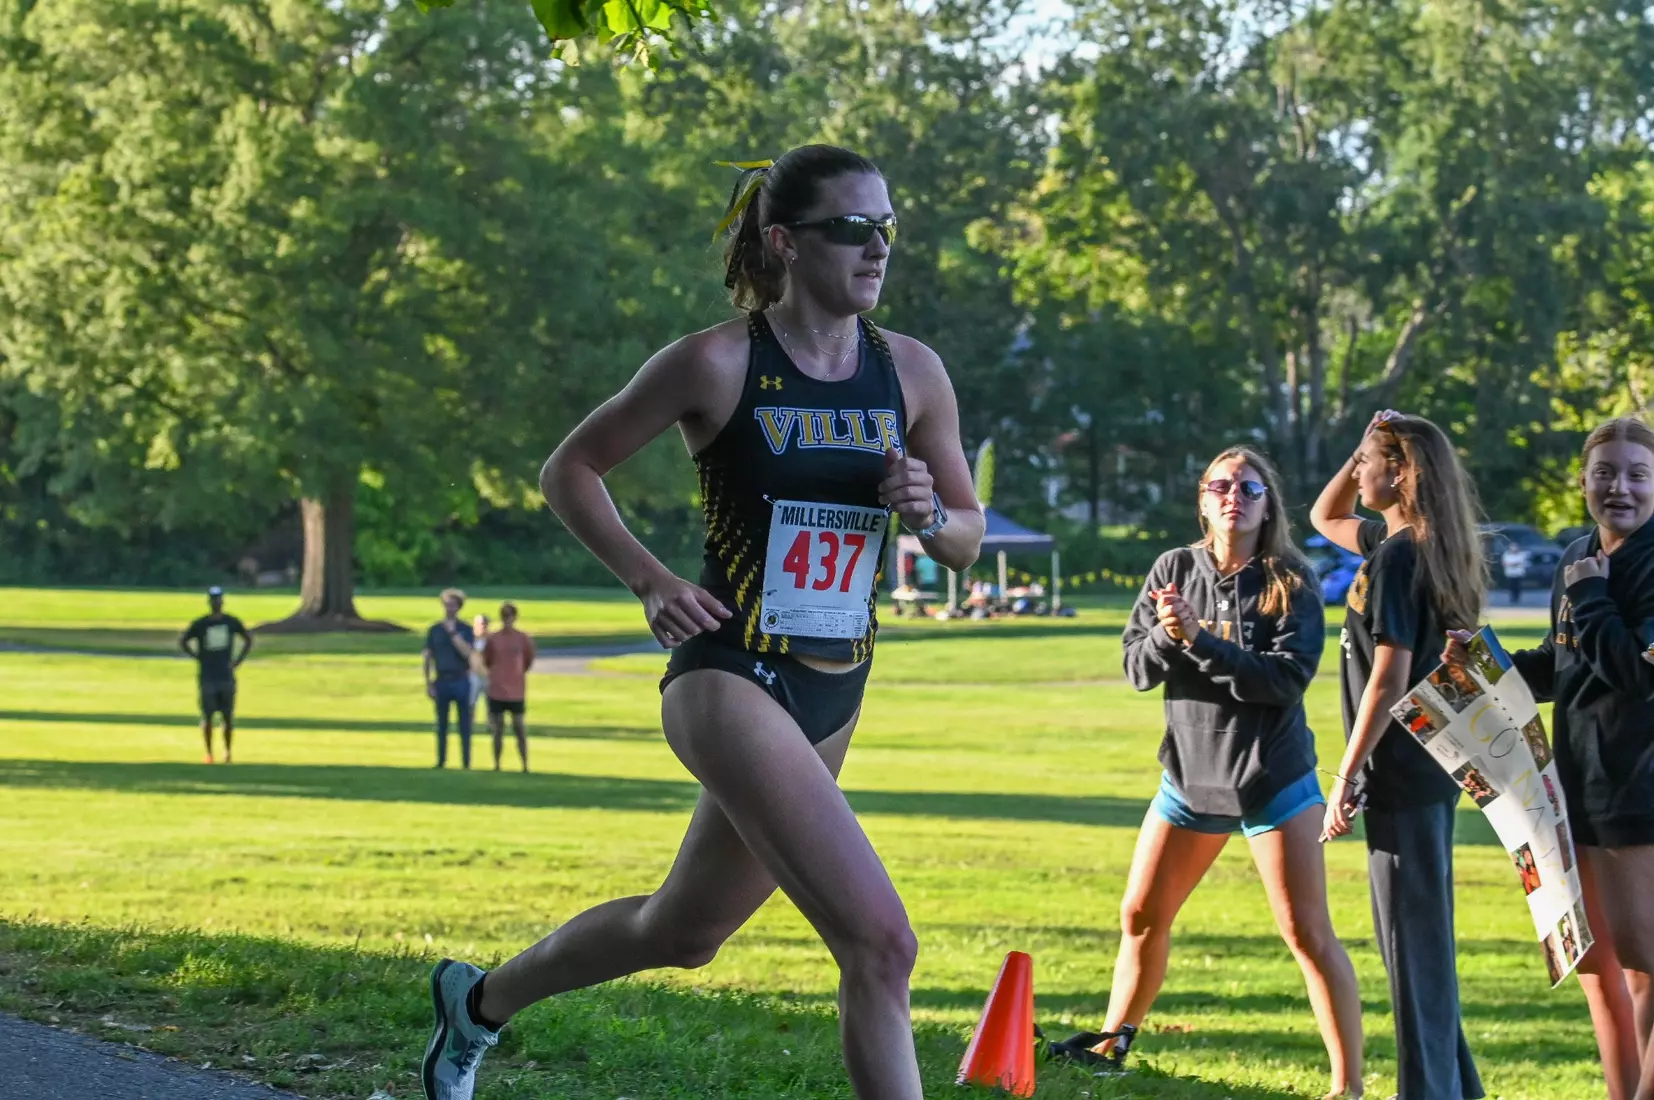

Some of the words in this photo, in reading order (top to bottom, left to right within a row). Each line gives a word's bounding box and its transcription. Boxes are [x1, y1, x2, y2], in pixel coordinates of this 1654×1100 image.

[754, 406, 903, 457] VILLE
[780, 505, 881, 532] MILLERSVILLE
[782, 530, 867, 593] 437
